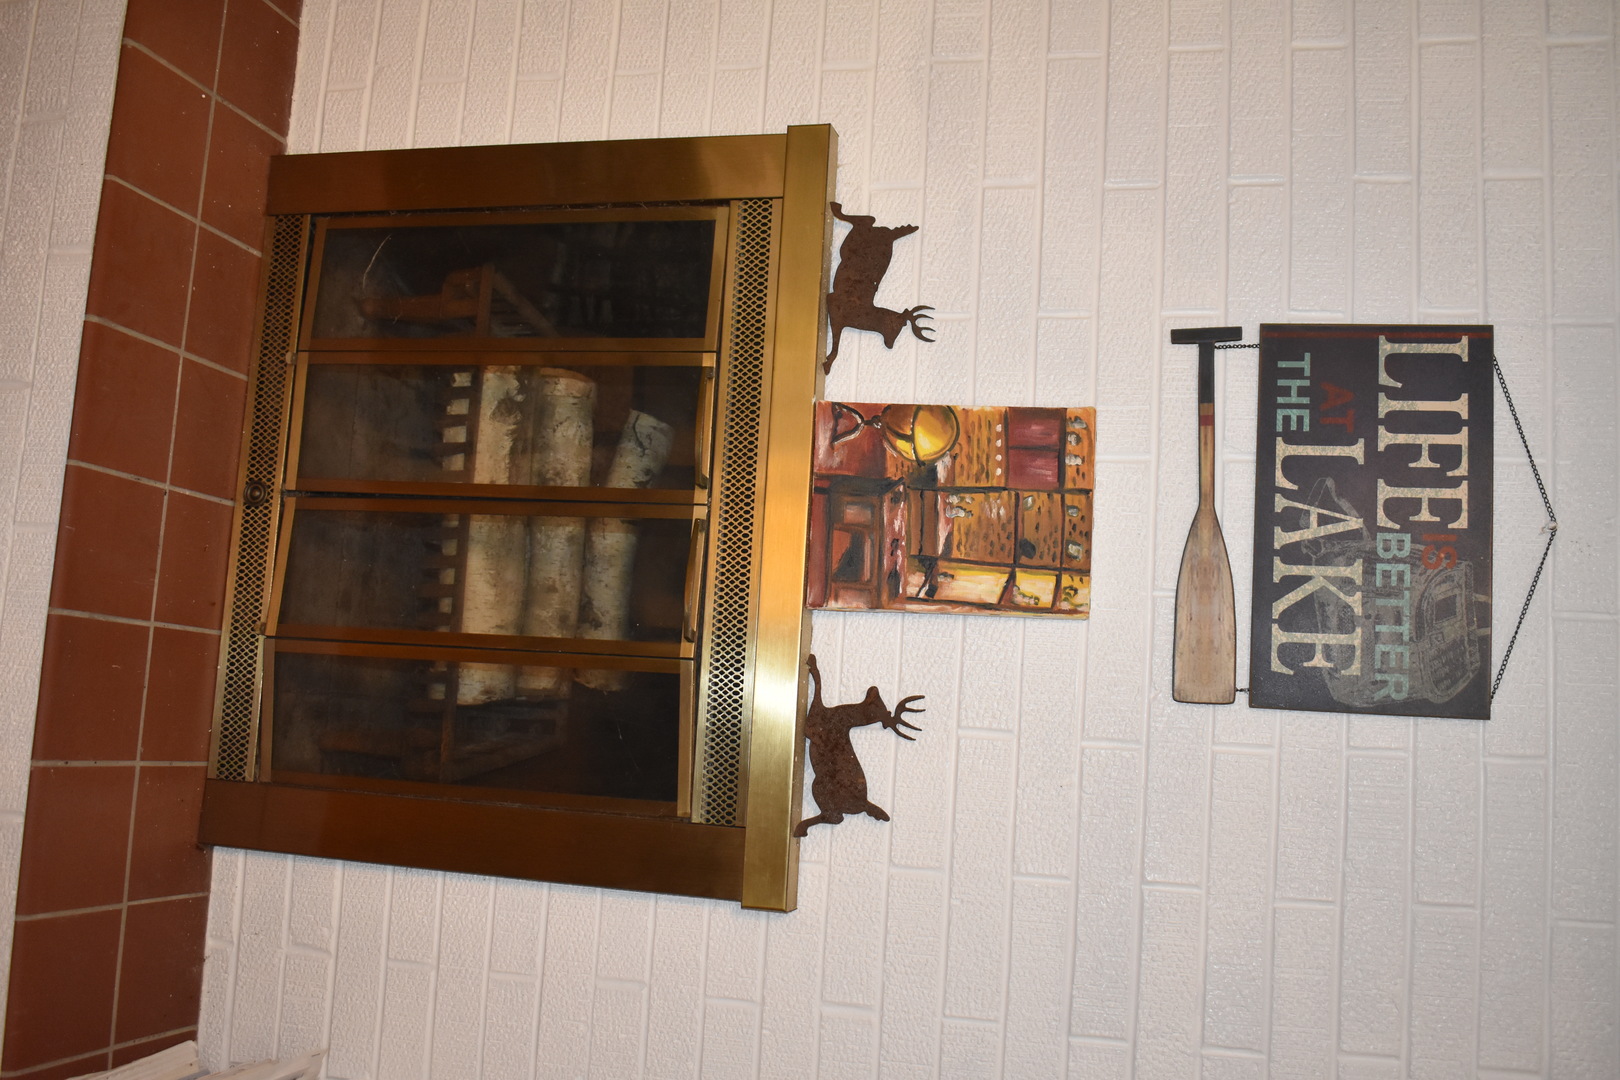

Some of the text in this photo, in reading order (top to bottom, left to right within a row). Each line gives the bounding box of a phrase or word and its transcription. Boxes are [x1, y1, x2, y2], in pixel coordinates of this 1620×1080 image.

[1320, 382, 1354, 432] AT
[1377, 335, 1469, 569] LIFE IS
[1272, 352, 1364, 675] THE LAKE
[1374, 533, 1411, 701] BETTER
